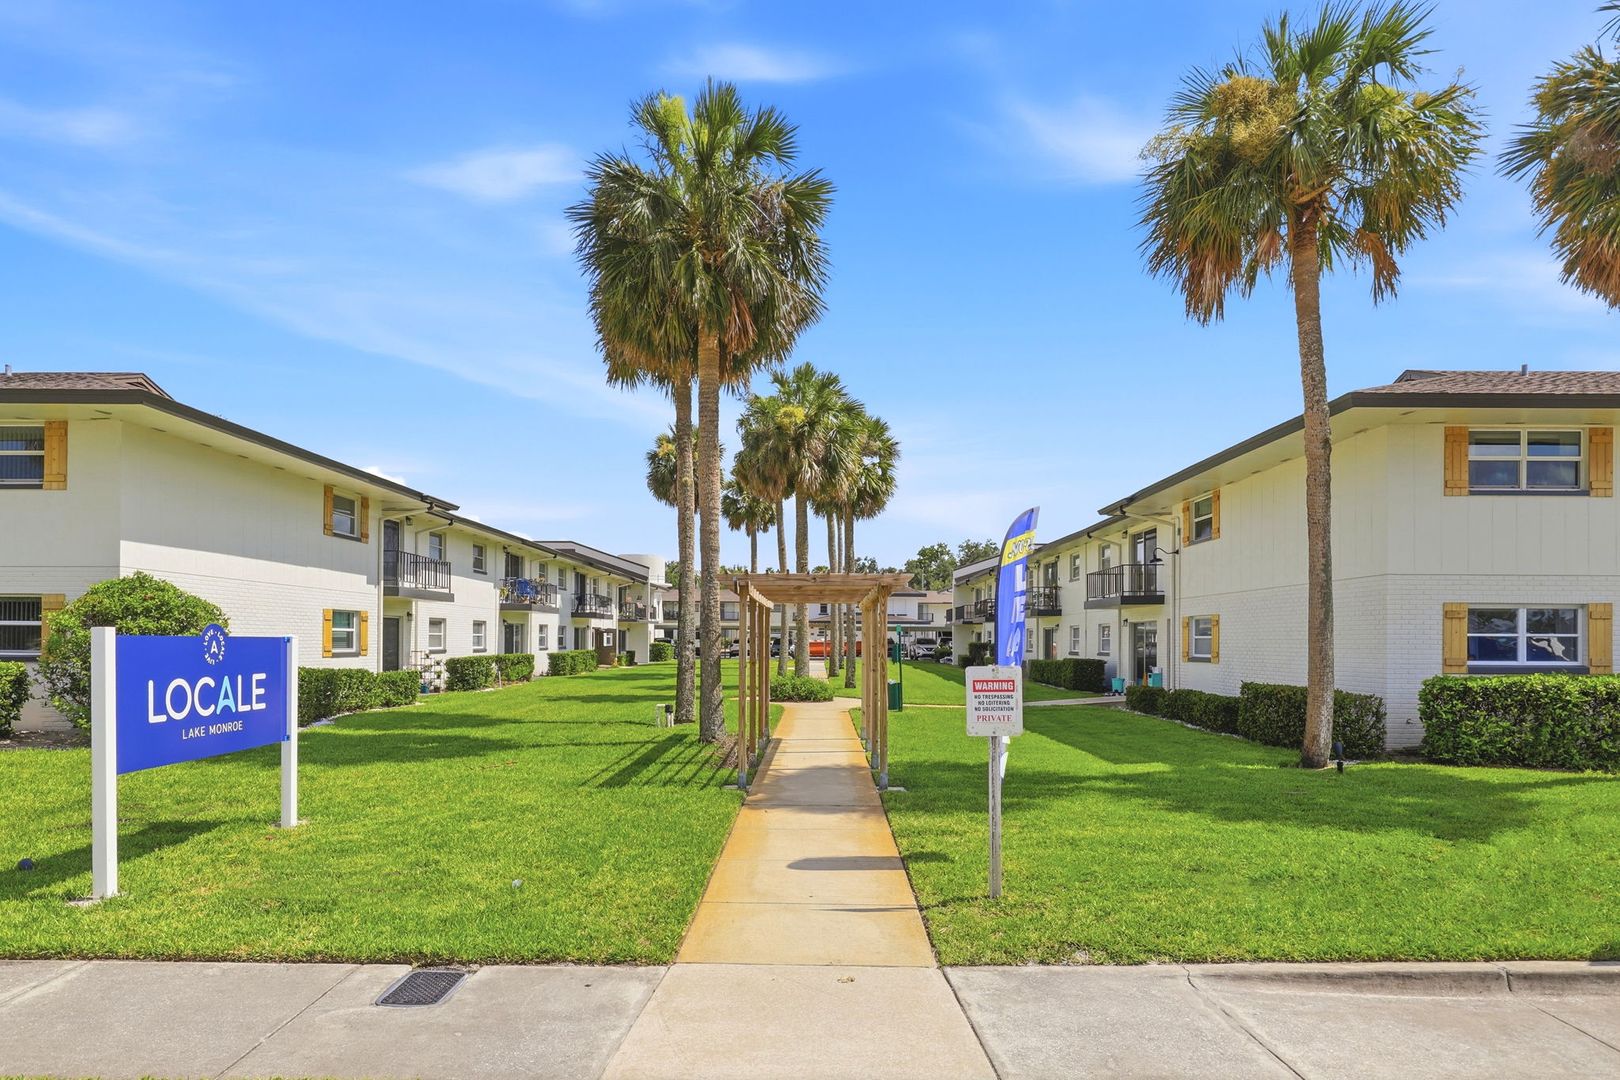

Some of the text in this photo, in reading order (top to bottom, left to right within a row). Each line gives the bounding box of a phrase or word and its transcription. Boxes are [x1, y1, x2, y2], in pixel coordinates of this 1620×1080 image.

[210, 640, 218, 654] A
[974, 681, 1014, 691] WARNING
[148, 673, 266, 723] LOCALE
[976, 714, 1013, 722] PRIVATE
[182, 720, 243, 740] LAKE MONROE
